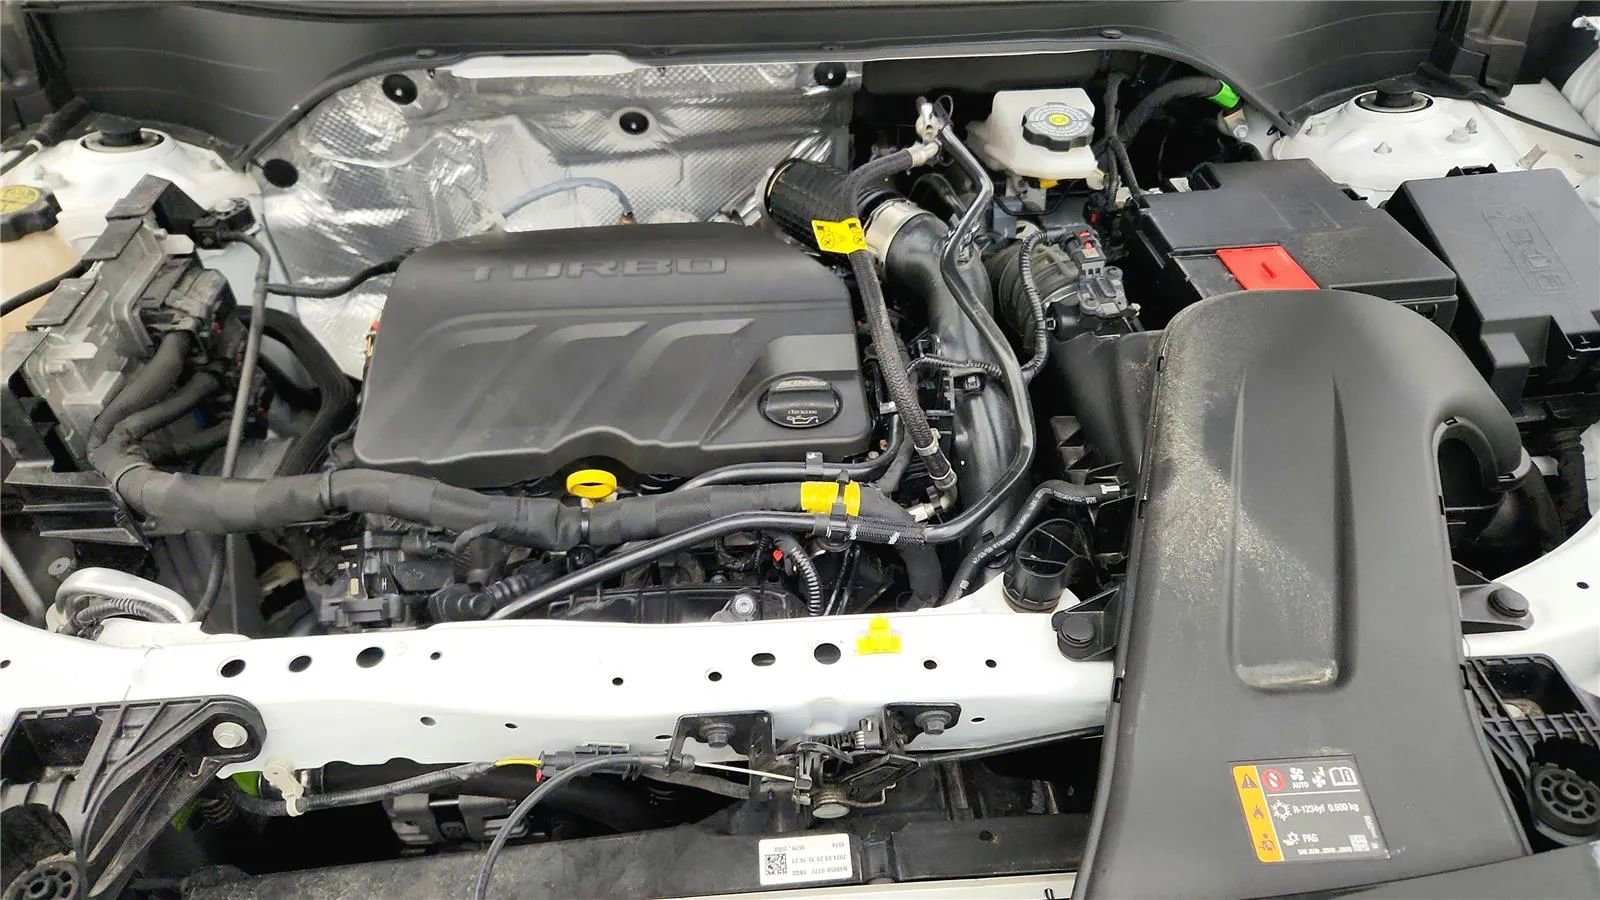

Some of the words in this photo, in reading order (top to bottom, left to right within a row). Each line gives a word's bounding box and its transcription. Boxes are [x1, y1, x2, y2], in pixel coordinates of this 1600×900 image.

[474, 258, 727, 282] TURBO
[1292, 781, 1309, 789] AUTO
[1292, 804, 1325, 814] R-1234yf
[1348, 802, 1359, 812] kg
[1302, 833, 1319, 843] PAG
